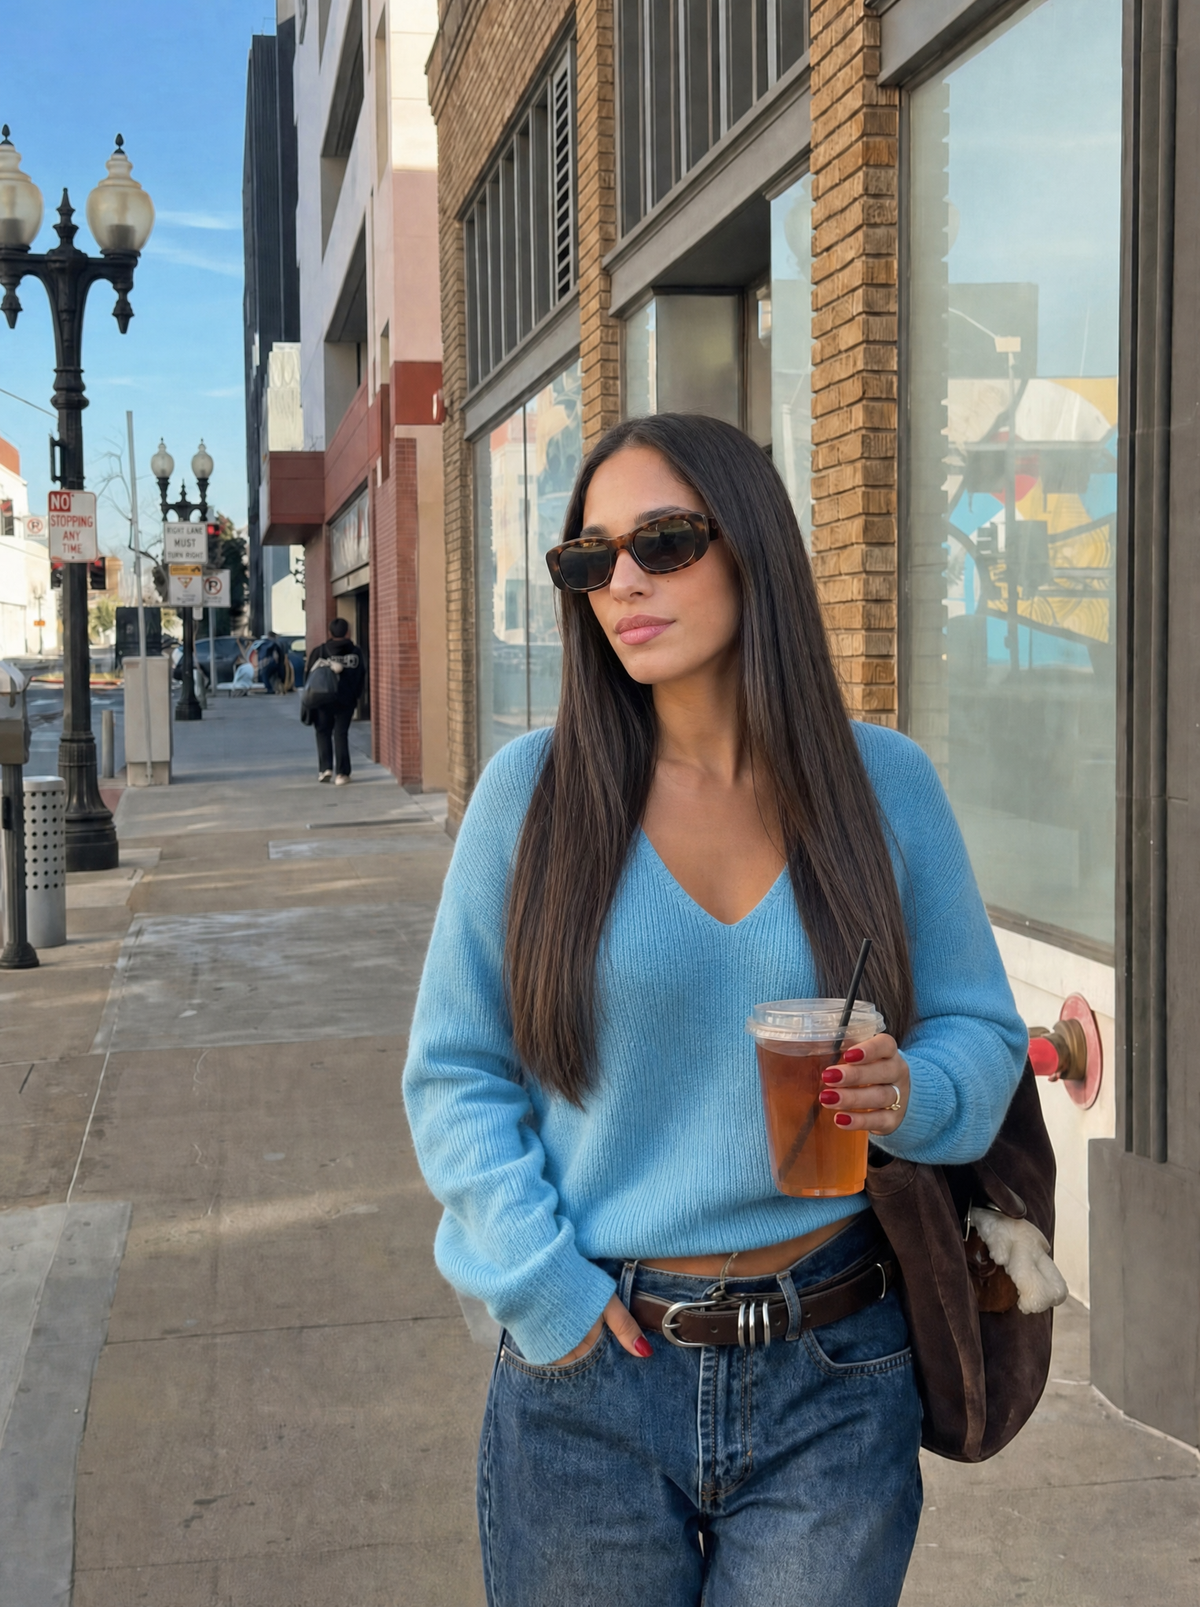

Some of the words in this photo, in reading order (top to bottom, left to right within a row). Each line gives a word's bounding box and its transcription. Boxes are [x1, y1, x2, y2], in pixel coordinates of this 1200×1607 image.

[51, 494, 70, 510] NO
[51, 514, 93, 527] STOPPING
[63, 530, 81, 541] ANY
[187, 527, 203, 535] LANE
[62, 543, 82, 554] TIME
[174, 538, 195, 548] MUST
[186, 552, 204, 560] RIGHT
[208, 580, 218, 592] P
